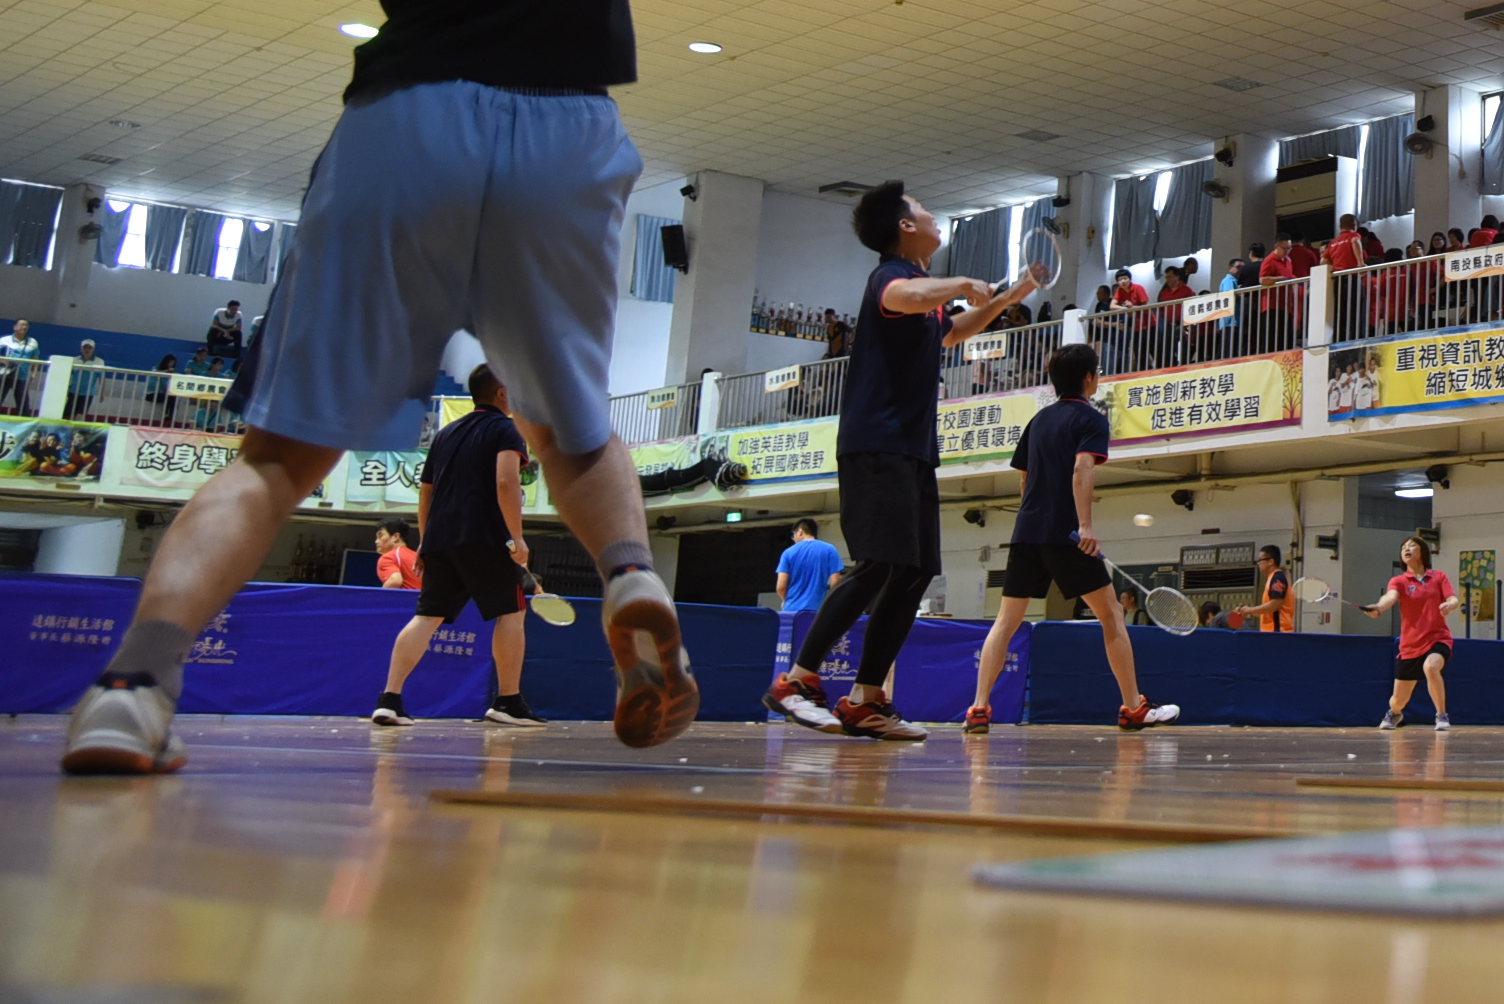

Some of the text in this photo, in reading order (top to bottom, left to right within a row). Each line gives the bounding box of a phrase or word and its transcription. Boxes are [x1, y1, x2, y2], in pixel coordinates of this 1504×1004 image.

[1450, 253, 1504, 273] 南投縣政府
[1126, 373, 1235, 409] 實施創新教學
[1151, 394, 1261, 431] 促進有效學習
[135, 440, 241, 474] 終身學
[736, 430, 810, 456] 加強英語教學
[750, 450, 825, 476] 拓展國際視野
